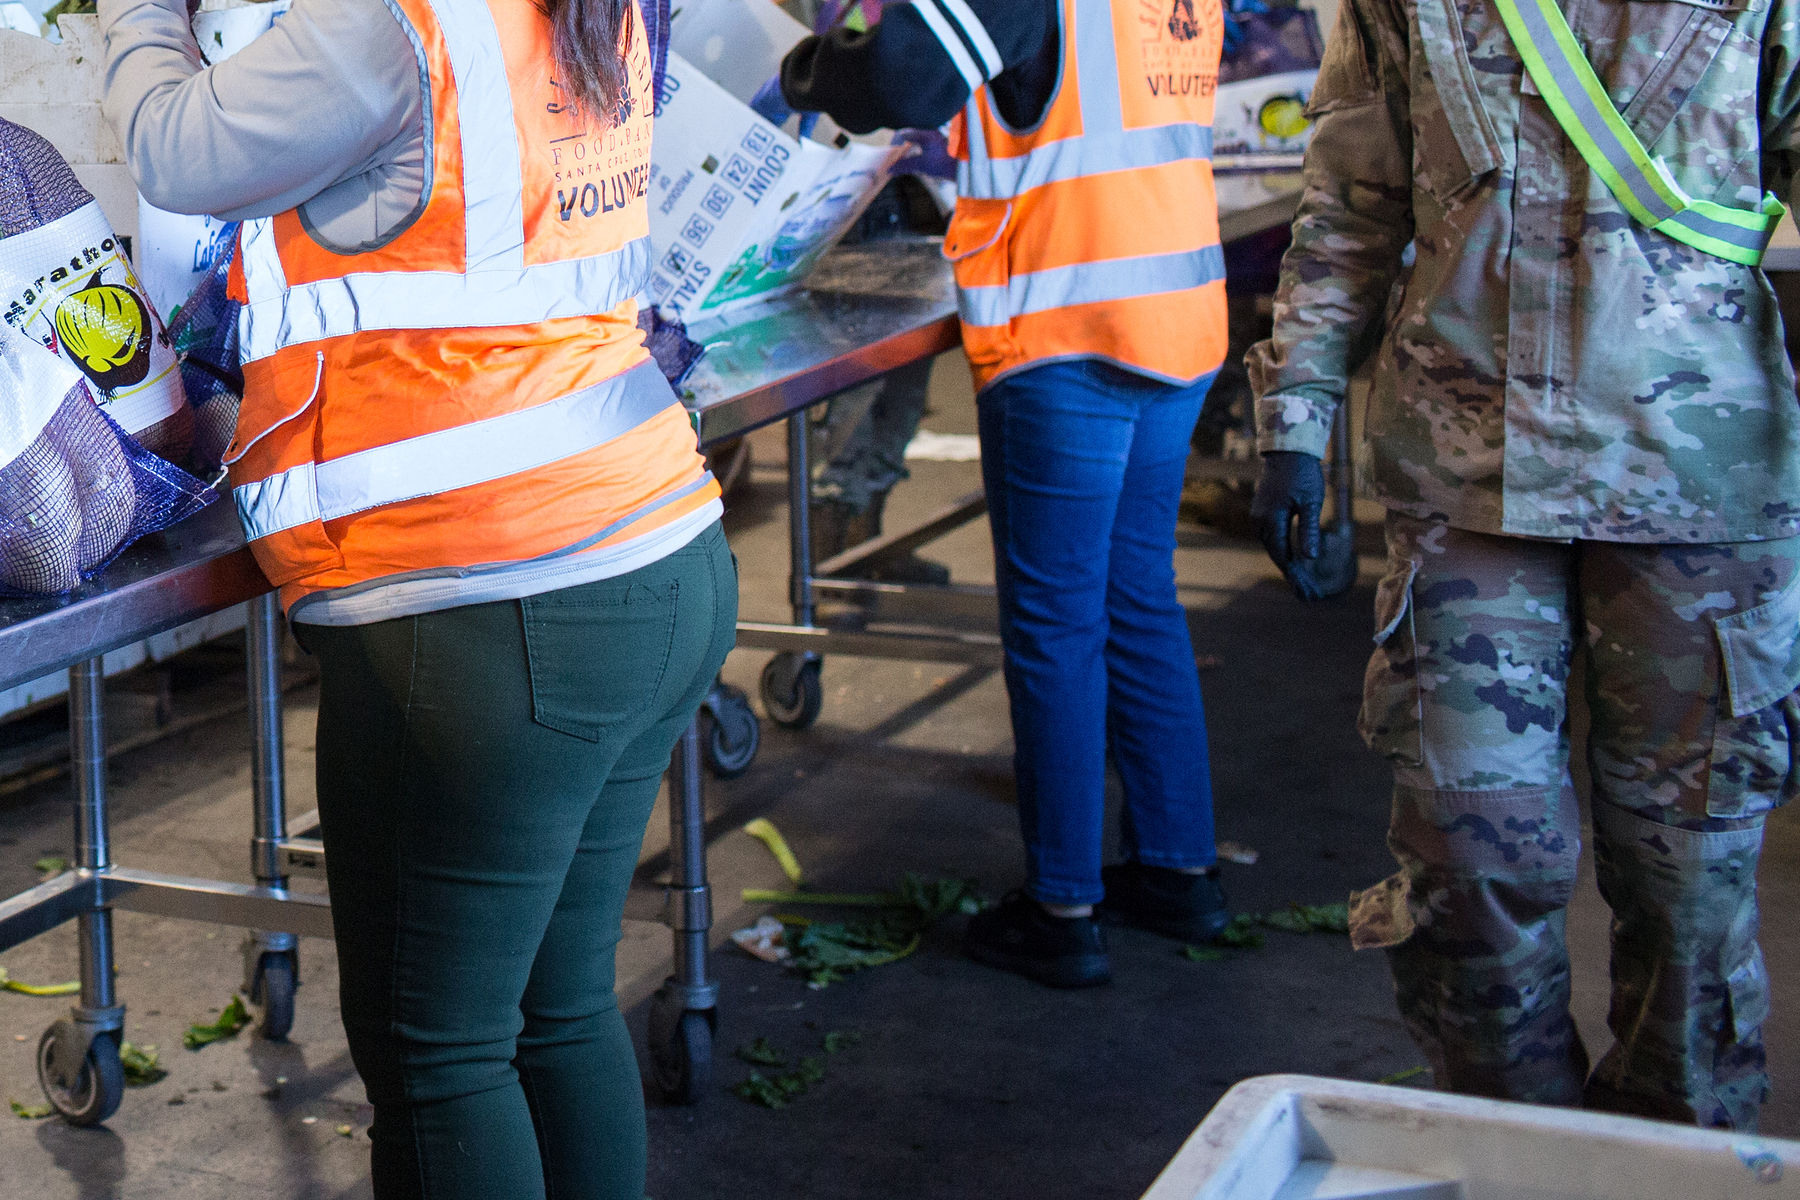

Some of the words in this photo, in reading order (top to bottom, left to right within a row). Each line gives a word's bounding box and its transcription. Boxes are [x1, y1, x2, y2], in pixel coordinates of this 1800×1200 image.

[552, 132, 616, 166] FOOD
[555, 161, 601, 183] SANTA
[727, 160, 749, 183] 24
[743, 144, 790, 206] COUNT
[659, 169, 695, 216] PRODUCE
[706, 189, 728, 213] 30
[686, 218, 708, 242] 36
[667, 259, 712, 317] STALK
